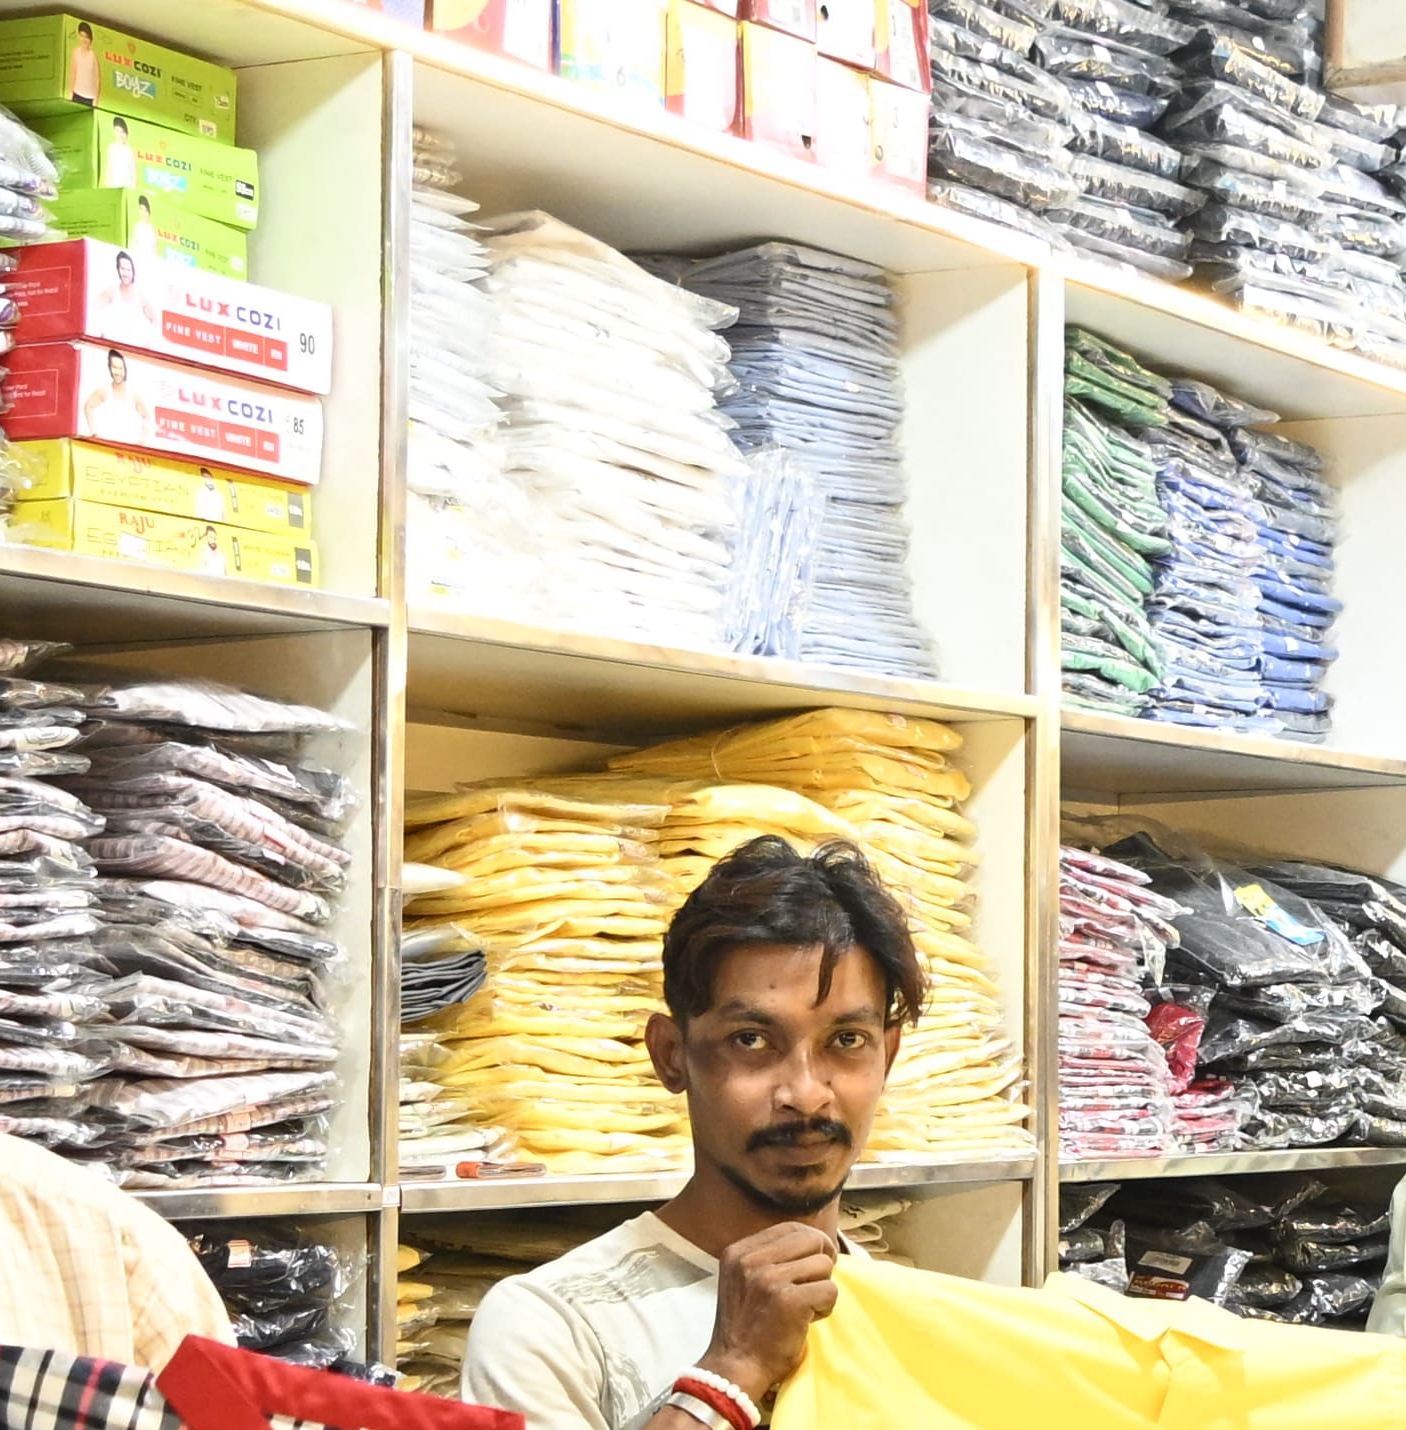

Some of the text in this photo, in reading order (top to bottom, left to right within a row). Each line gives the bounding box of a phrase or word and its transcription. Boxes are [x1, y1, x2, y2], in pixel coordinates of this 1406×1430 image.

[134, 60, 161, 78] COZI
[165, 157, 192, 171] COZI
[179, 236, 200, 251] COZI
[186, 293, 281, 331] LUX COZI
[166, 322, 191, 337] FINE
[195, 329, 222, 345] VEST
[299, 333, 316, 355] 90
[178, 388, 273, 424] LUX COZI
[293, 417, 305, 435] 85
[119, 512, 155, 535] RAJU
